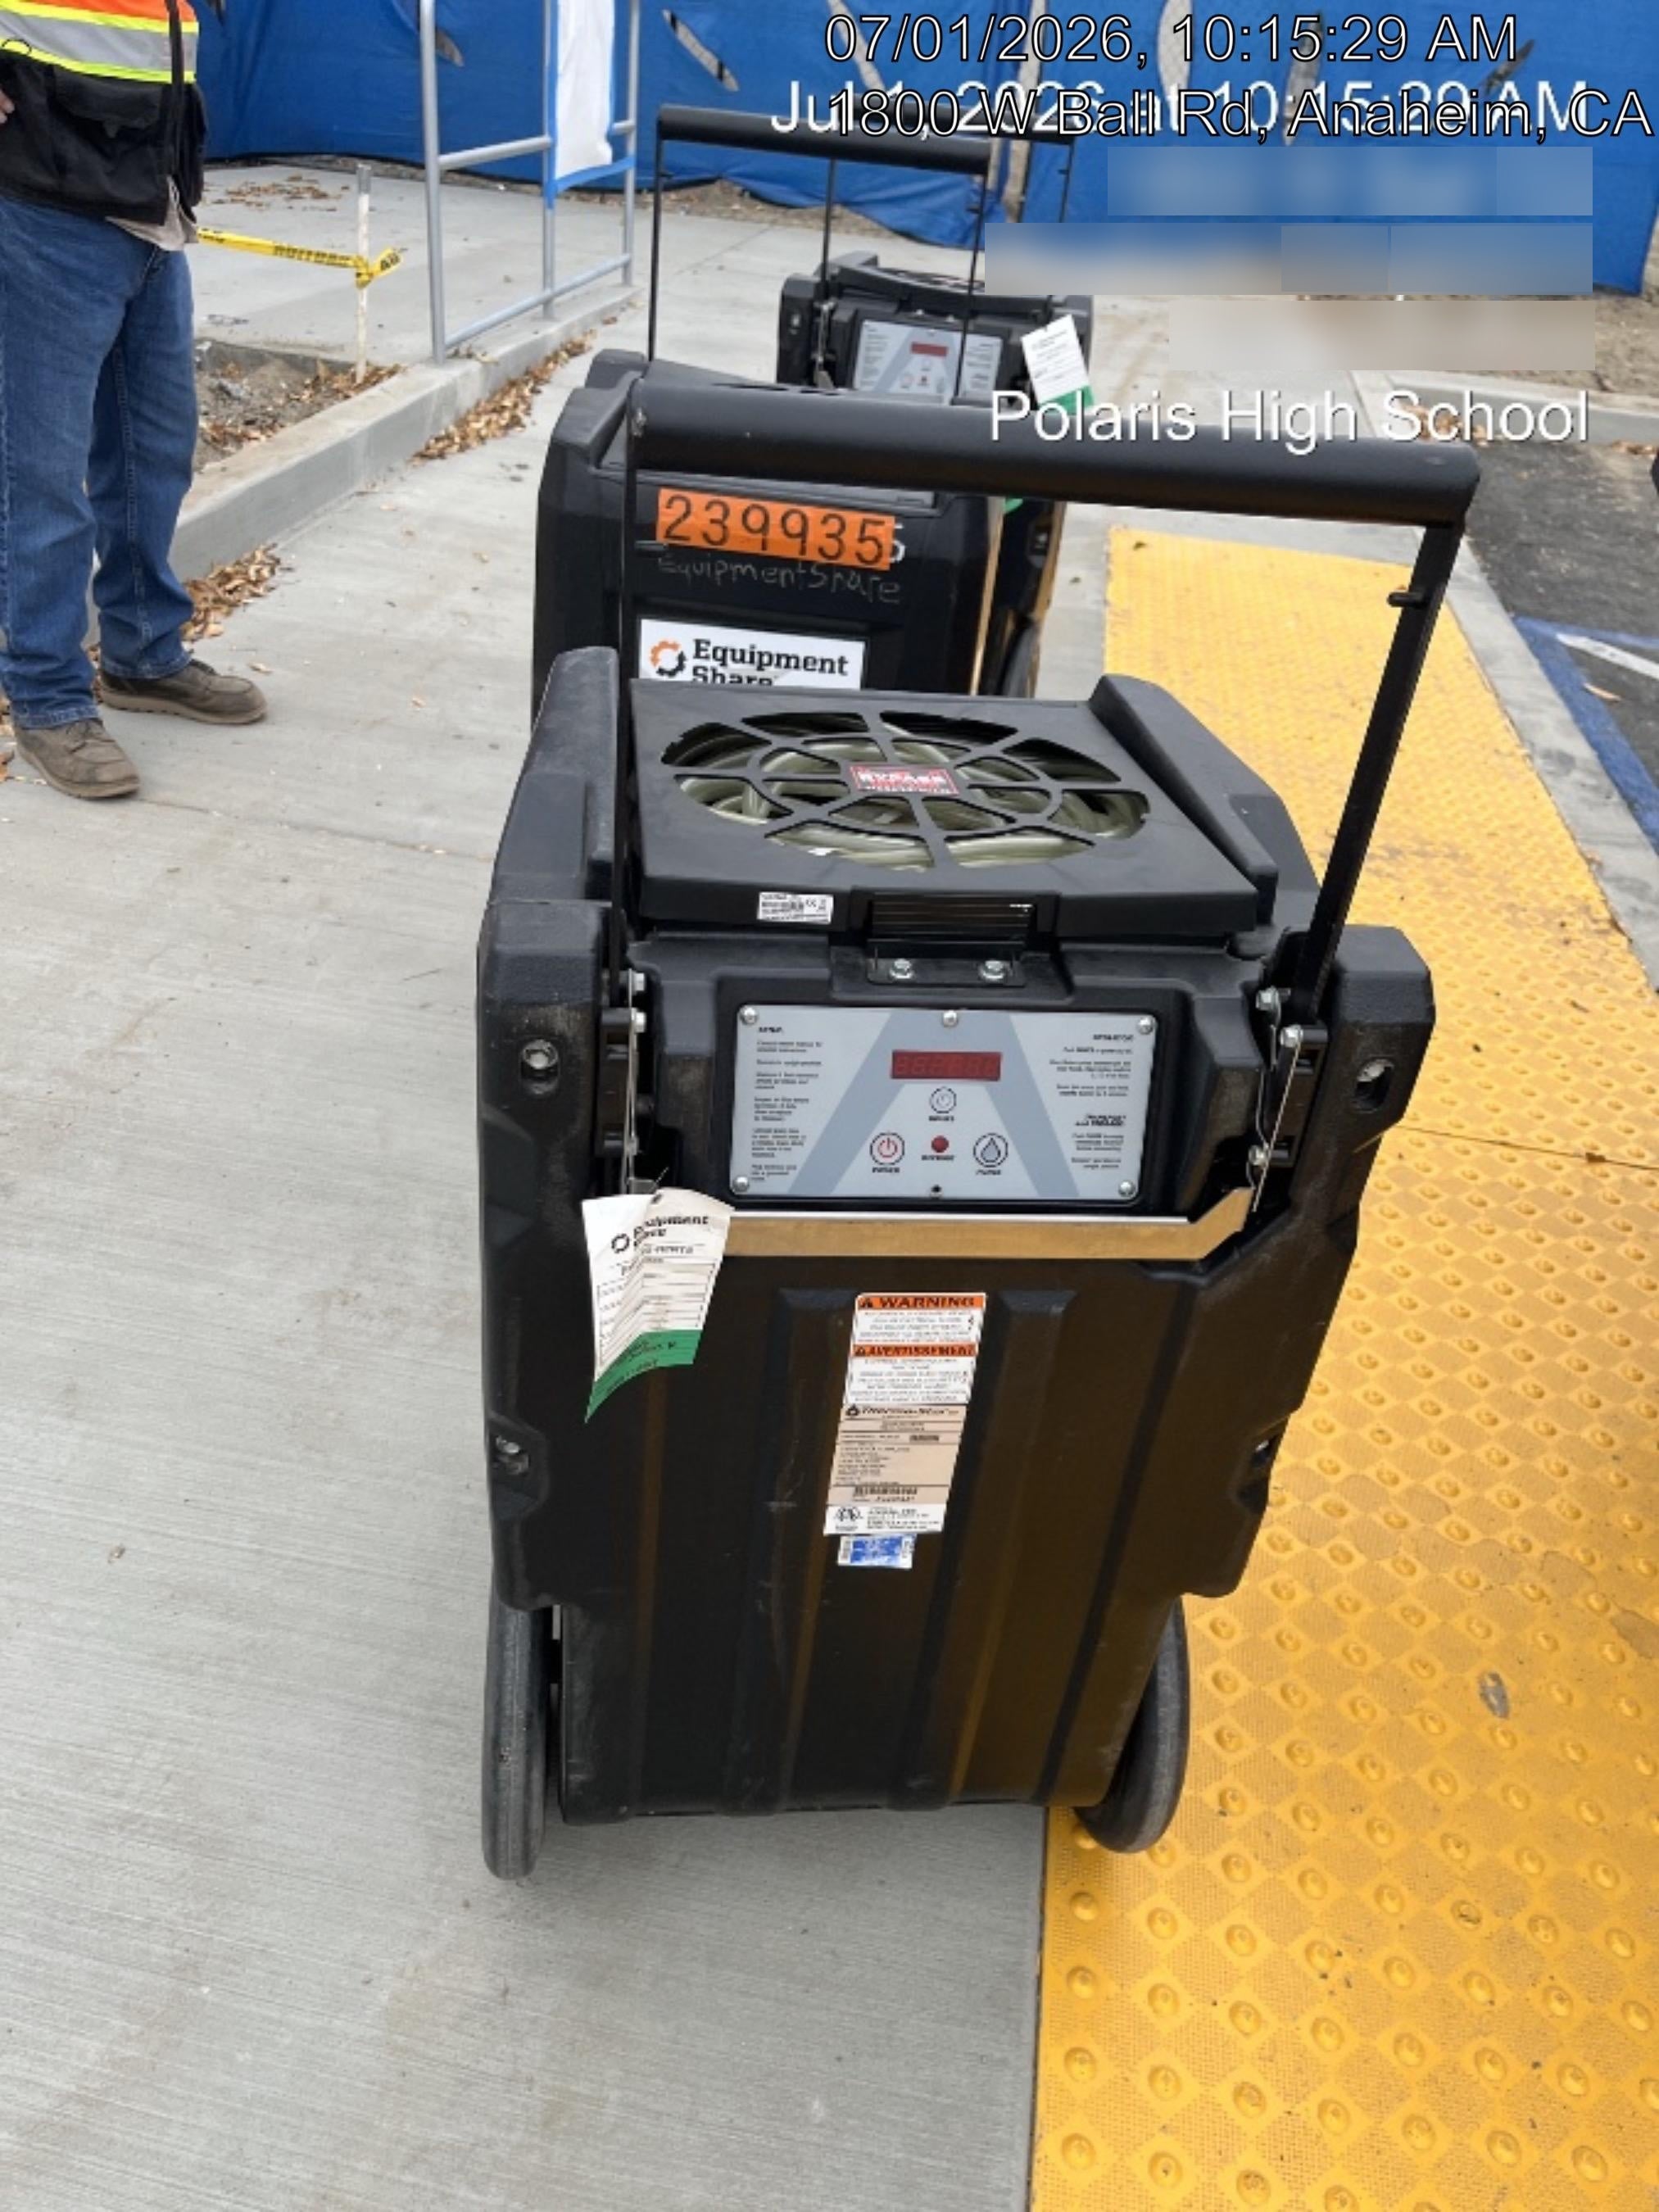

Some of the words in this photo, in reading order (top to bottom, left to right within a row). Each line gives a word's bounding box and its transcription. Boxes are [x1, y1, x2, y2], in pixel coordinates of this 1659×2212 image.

[662, 494, 887, 565] 239935
[692, 638, 850, 675] Equipment
[878, 1296, 976, 1309] WARNING
